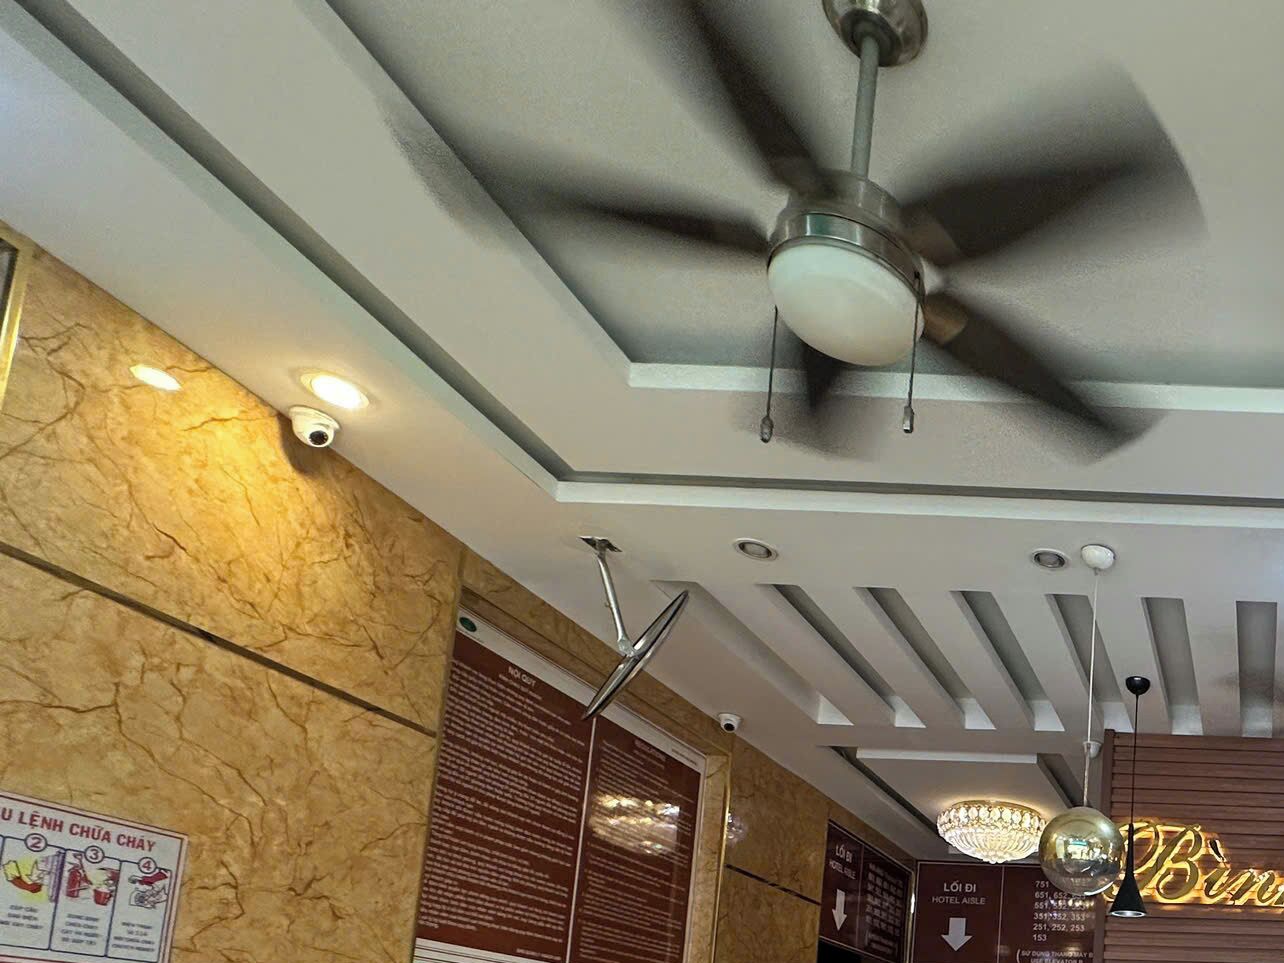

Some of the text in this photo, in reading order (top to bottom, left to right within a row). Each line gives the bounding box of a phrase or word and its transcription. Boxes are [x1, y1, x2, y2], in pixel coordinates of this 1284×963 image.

[18, 810, 64, 833] LỆNH
[69, 823, 112, 843] CHỮA
[116, 834, 156, 852] CHÁY
[30, 836, 42, 849] 2
[89, 848, 100, 860] 3
[142, 860, 152, 871] 4
[943, 880, 976, 893] LỐI ĐI
[932, 896, 986, 905] HOTEL AISLE
[1033, 923, 1085, 932] 251, 252, 253
[1032, 934, 1047, 942] 153
